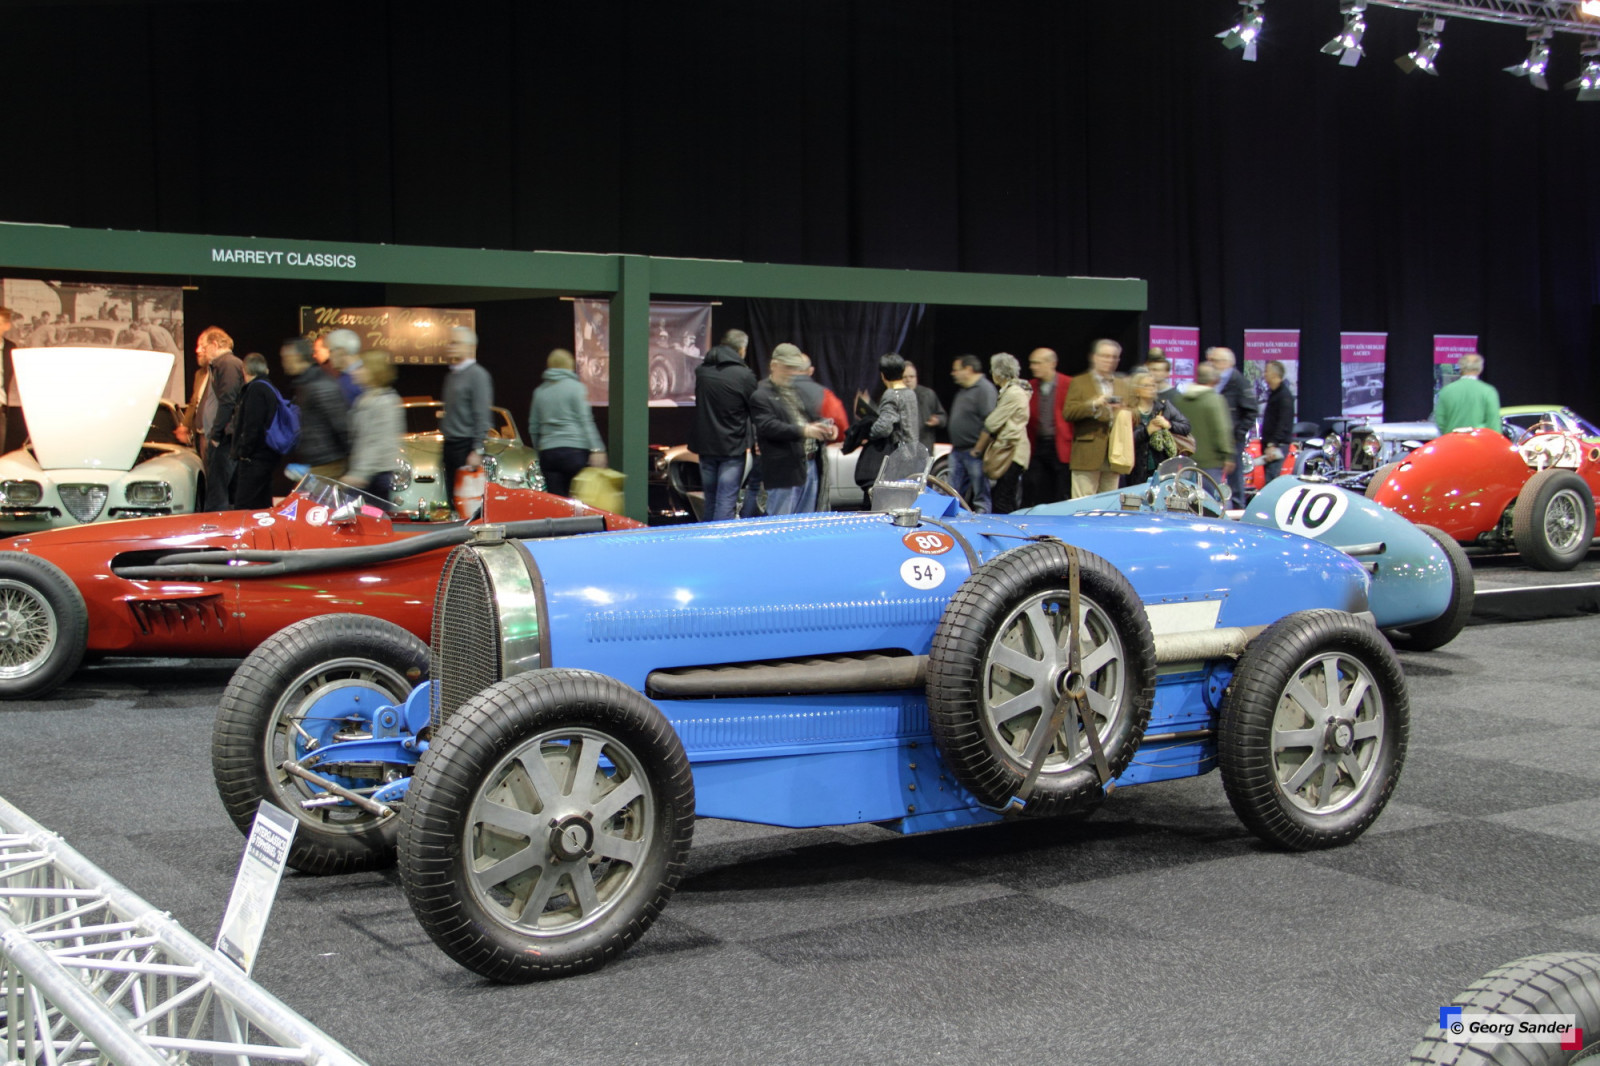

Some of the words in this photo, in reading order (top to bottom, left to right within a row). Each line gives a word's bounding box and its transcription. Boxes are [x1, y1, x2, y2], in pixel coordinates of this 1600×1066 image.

[212, 249, 284, 265] MARREYT
[286, 252, 357, 268] CLASSICS
[314, 307, 389, 329] Marreyt
[367, 331, 410, 347] Twin
[1285, 488, 1338, 529] 10
[915, 534, 943, 550] 80
[913, 565, 933, 581] 54
